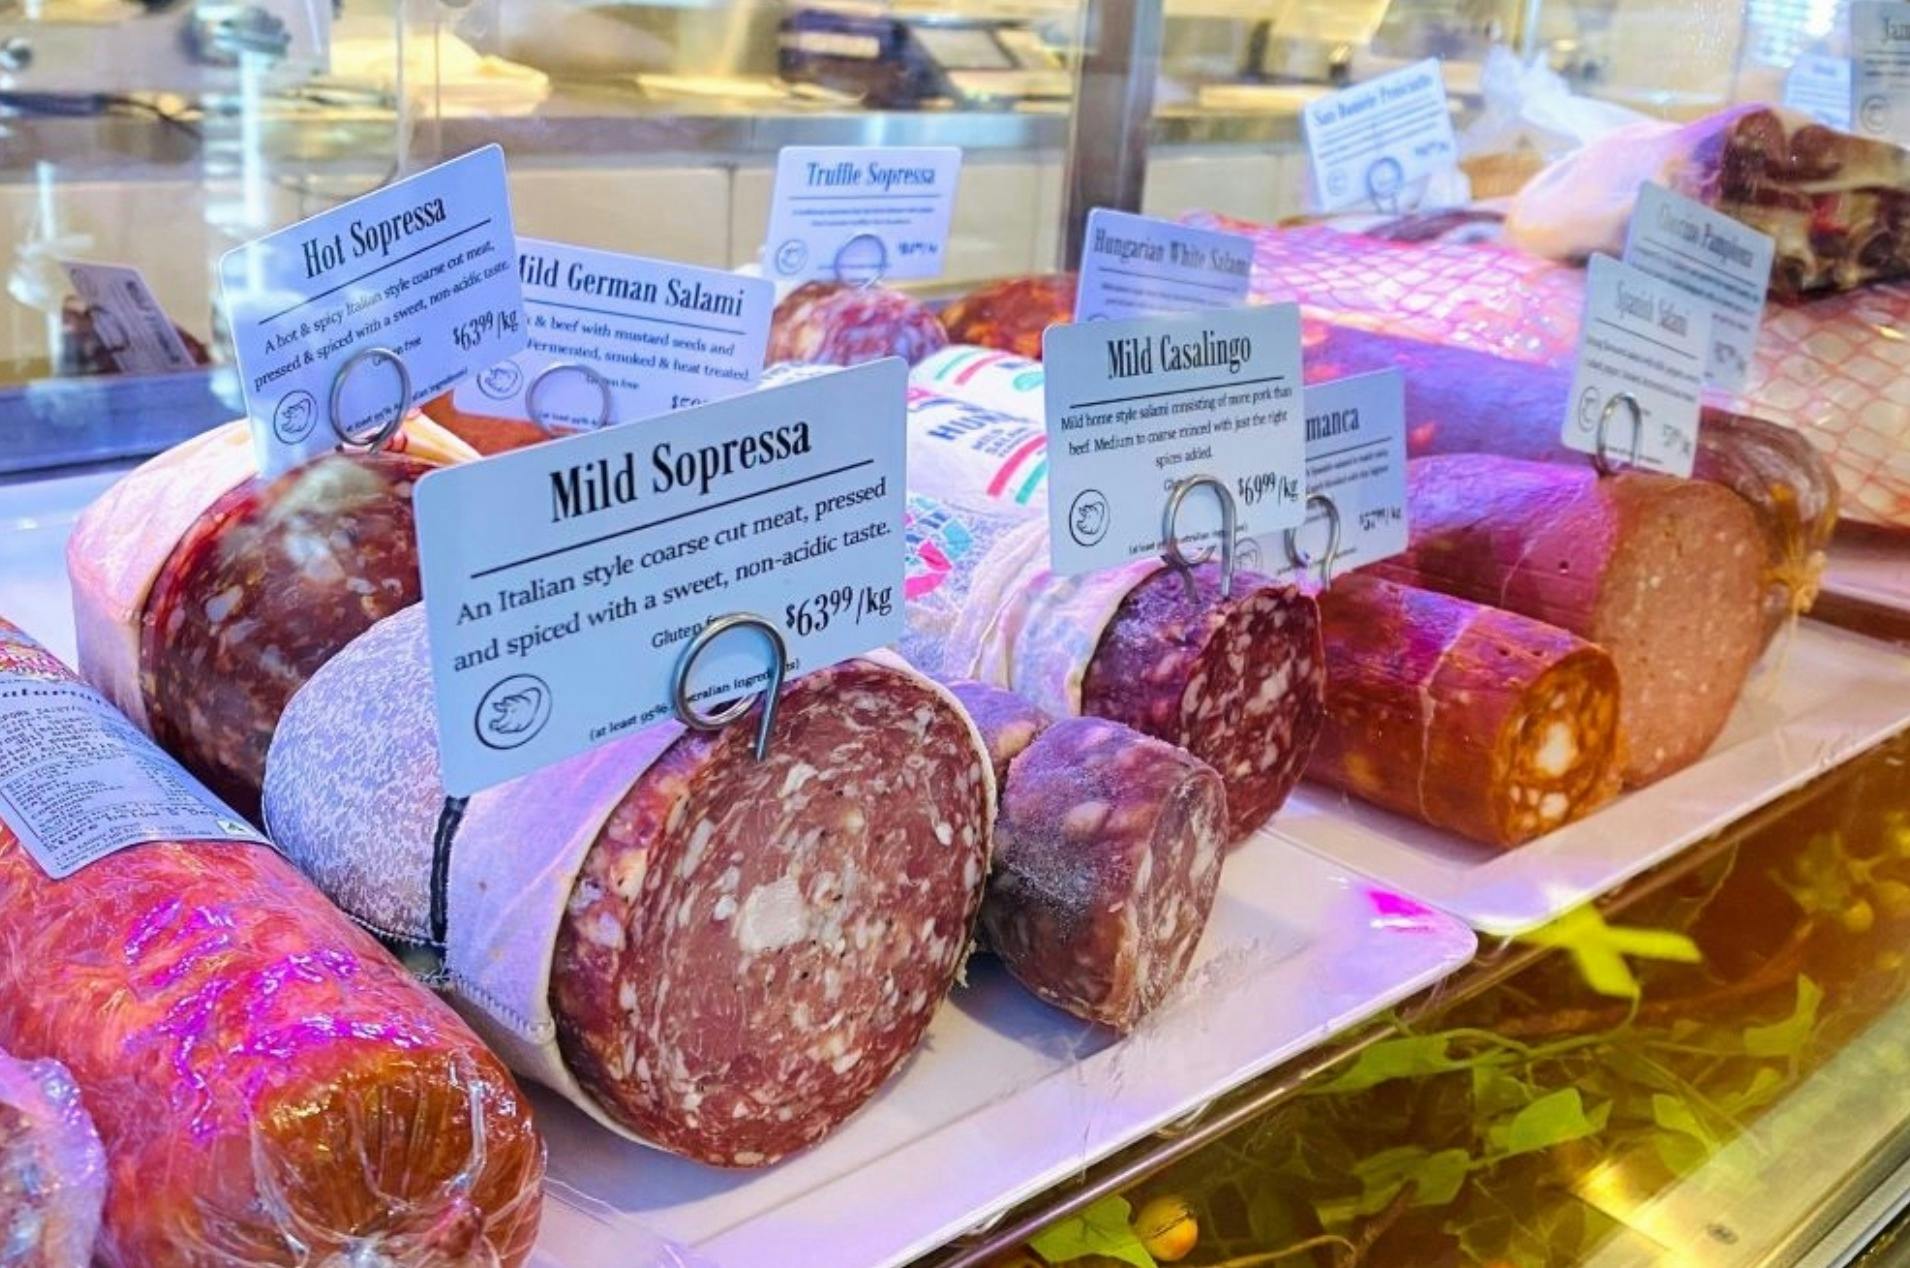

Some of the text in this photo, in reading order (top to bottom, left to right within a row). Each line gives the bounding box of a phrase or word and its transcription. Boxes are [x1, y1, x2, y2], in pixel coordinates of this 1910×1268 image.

[806, 162, 937, 192] Truffle Sopressa
[301, 197, 447, 279] Hot Sopressa
[1093, 228, 1165, 264] Hungarian
[1169, 240, 1206, 268] White
[264, 338, 276, 355] A
[275, 329, 299, 348] hot
[300, 322, 311, 338] &
[313, 309, 343, 332] spicy
[345, 293, 383, 316] Italian
[384, 278, 410, 299] style
[412, 263, 446, 285] coarse
[447, 252, 464, 270] cut
[567, 261, 658, 305] German
[665, 277, 745, 318] Salami
[254, 353, 302, 392] pressed
[303, 349, 315, 366] &
[316, 329, 354, 360] spiced
[355, 318, 382, 339] with
[383, 316, 391, 327] a
[393, 298, 427, 322] sweet,
[534, 315, 736, 356] & beef with mustard seeds and
[1106, 330, 1252, 380] Mild Casalingo
[604, 350, 656, 368] smoked
[658, 357, 669, 369] &
[673, 359, 701, 374] heat
[1060, 413, 1084, 431] Mild
[1085, 412, 1114, 427] home
[1115, 408, 1138, 425] style
[1139, 403, 1169, 419] salami
[1252, 386, 1272, 406] pork
[1273, 385, 1293, 399] than
[1305, 407, 1361, 442] manca
[1093, 436, 1134, 453] Medium
[1147, 429, 1177, 444] coarse
[1213, 417, 1233, 432] with
[1234, 416, 1250, 432] just
[1252, 412, 1266, 427] the
[1267, 410, 1288, 426] right
[548, 420, 812, 524] Mild Sopressa
[1155, 452, 1182, 470] spices
[455, 475, 888, 627] An Italian style coarse cut meat, pressed
[453, 637, 500, 673] and
[506, 611, 581, 658] spiced
[586, 595, 638, 627] with
[643, 593, 658, 611] a
[662, 569, 730, 605] sweet,
[735, 534, 839, 582] non-acidic
[843, 519, 893, 548] taste.
[609, 713, 637, 733] least
